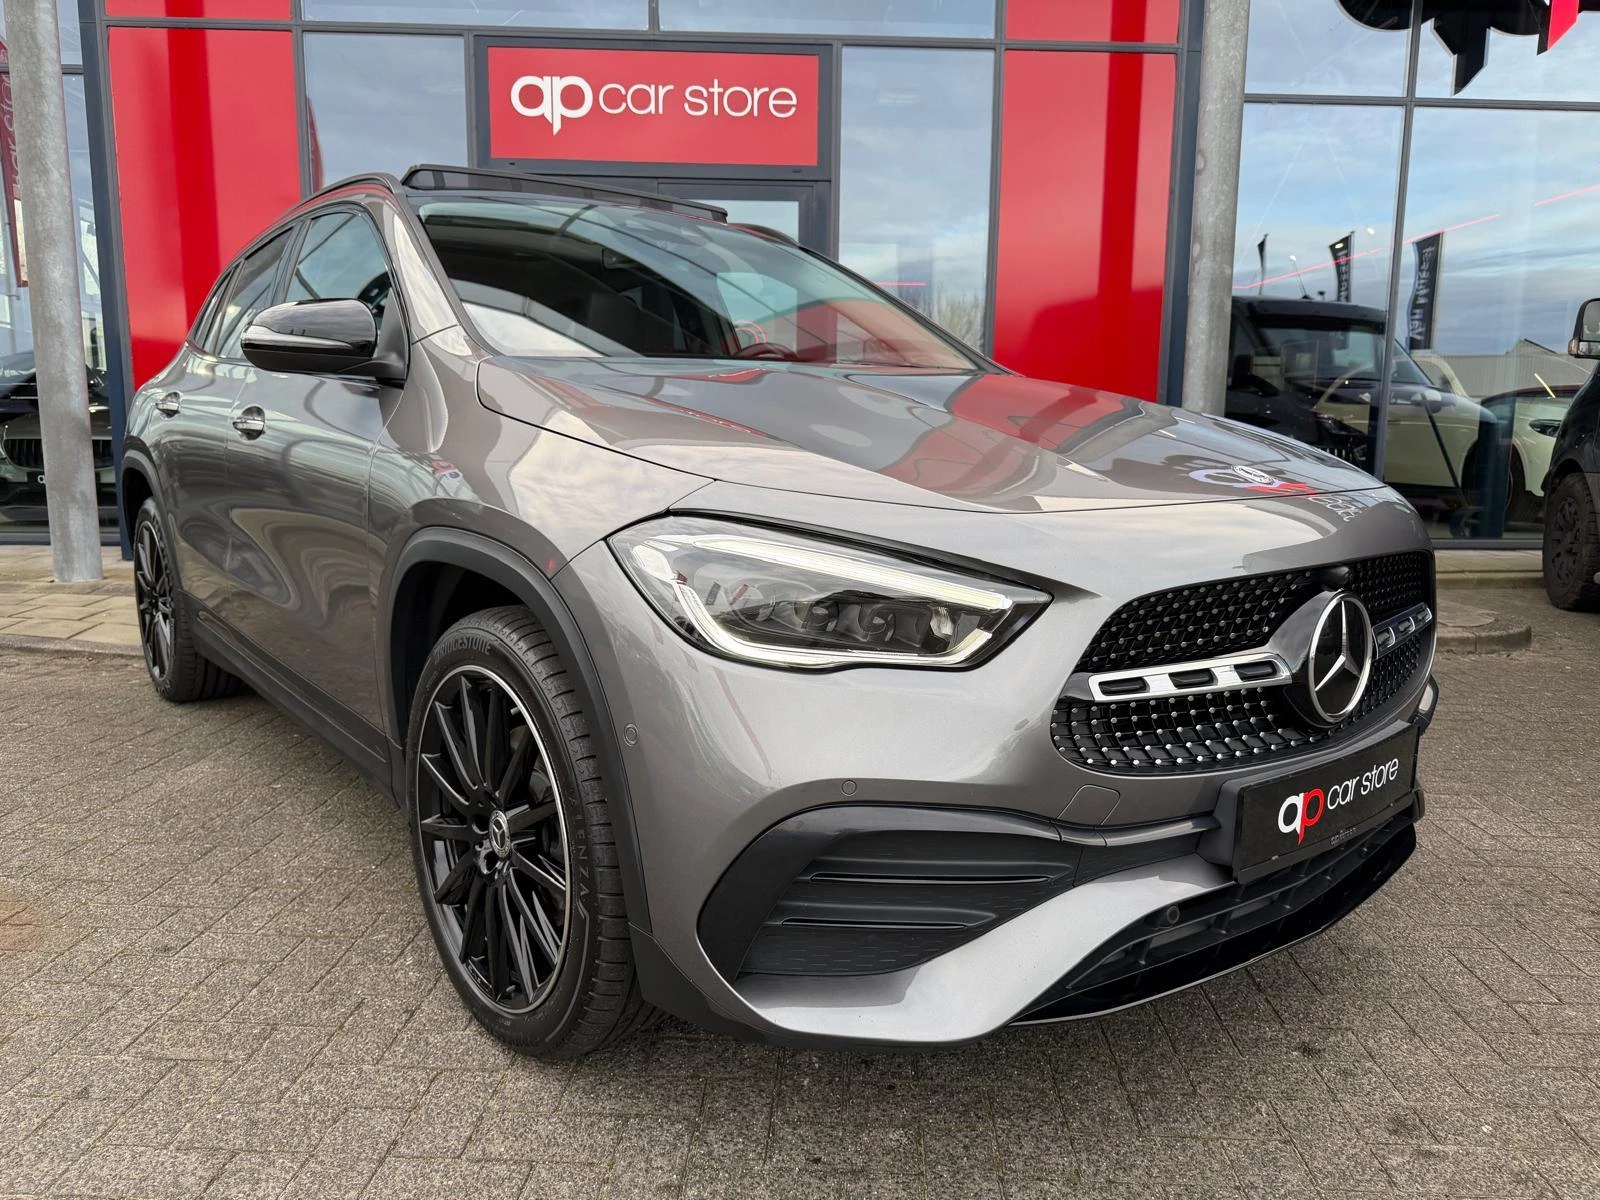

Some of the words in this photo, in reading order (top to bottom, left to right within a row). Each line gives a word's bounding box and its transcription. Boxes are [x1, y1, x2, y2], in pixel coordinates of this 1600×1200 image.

[510, 75, 594, 136] ap
[598, 83, 675, 115] car
[684, 78, 798, 119] store
[1277, 788, 1325, 846] ap
[1327, 776, 1359, 810] car
[1360, 758, 1399, 796] store
